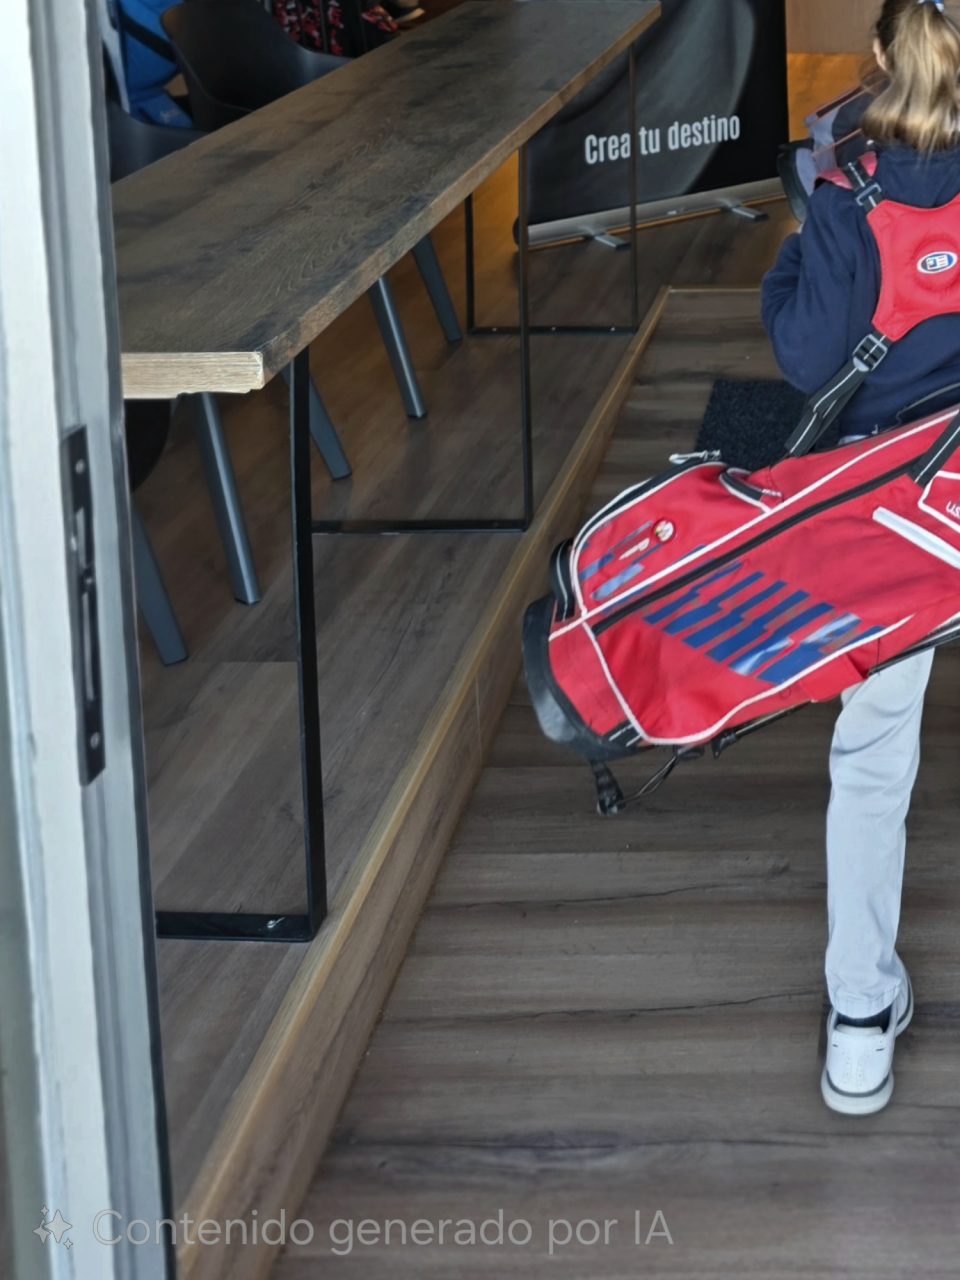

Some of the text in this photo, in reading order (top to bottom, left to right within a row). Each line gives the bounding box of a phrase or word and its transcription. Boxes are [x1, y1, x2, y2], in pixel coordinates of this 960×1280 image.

[584, 114, 741, 165] Crea tu destino
